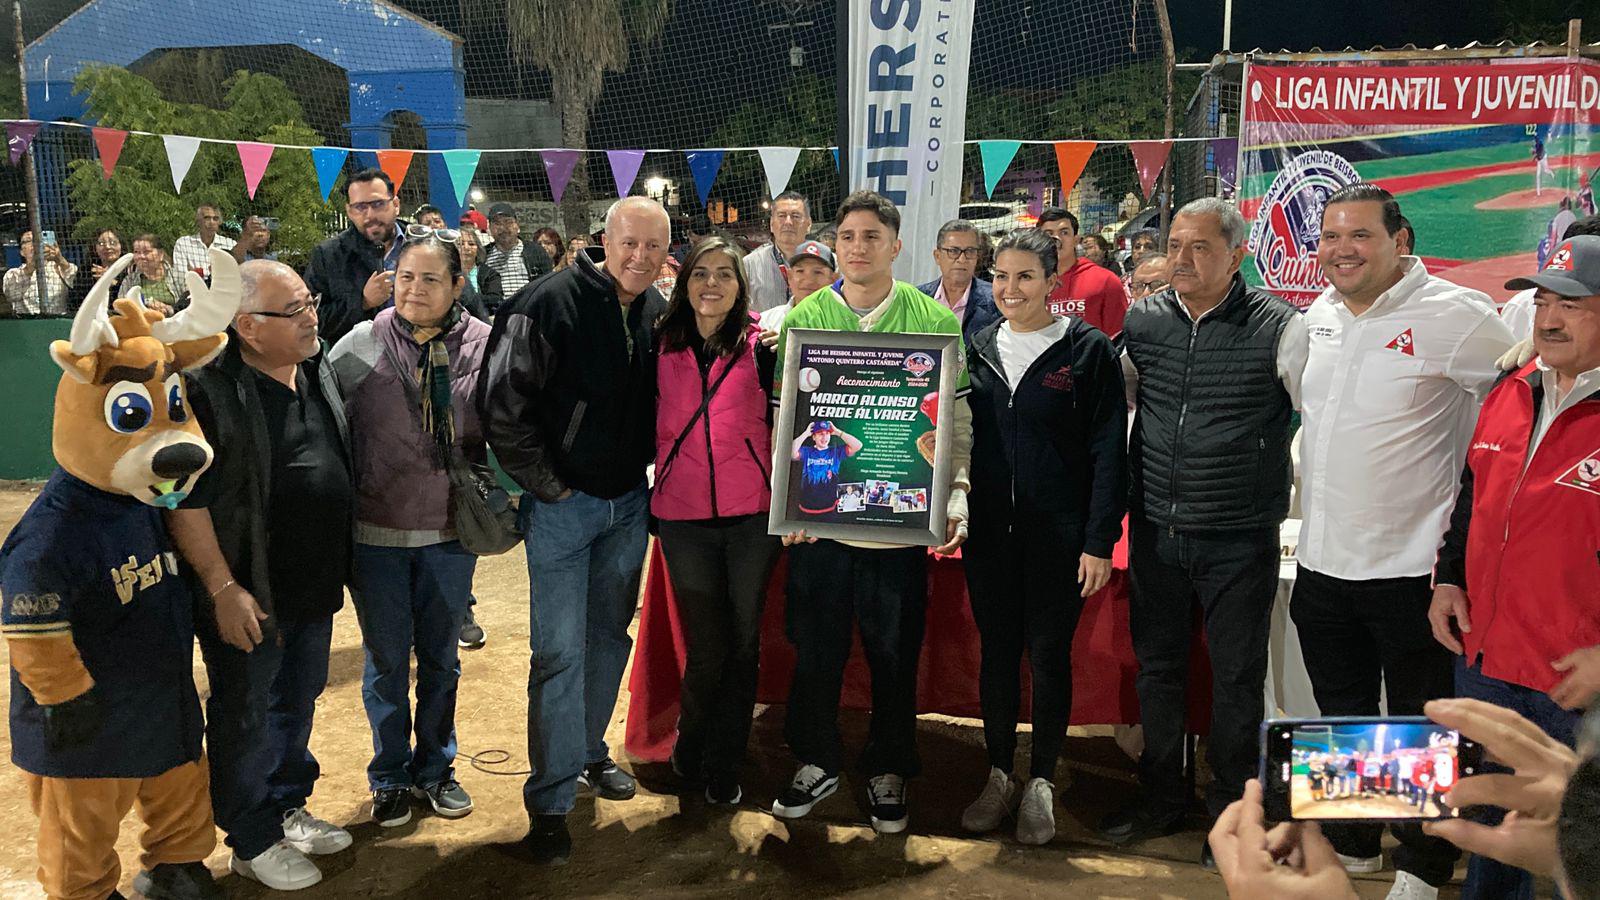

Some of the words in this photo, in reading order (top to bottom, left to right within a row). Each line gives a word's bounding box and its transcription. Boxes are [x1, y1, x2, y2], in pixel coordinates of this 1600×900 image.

[1275, 76, 1329, 110] LIGA
[1334, 76, 1447, 110] INFANTIL
[1453, 76, 1472, 110] Y
[1471, 74, 1577, 119] JUVENIL
[1580, 75, 1600, 110] D
[1249, 222, 1261, 250] LIGA
[1258, 170, 1288, 218] INFANTIL
[1323, 153, 1334, 166] DE
[1264, 237, 1330, 289] Quint
[835, 358, 865, 366] QUINTERO
[836, 375, 901, 388] Reconocimiento
[810, 392, 859, 406] MARCO
[860, 394, 918, 408] ALONSO
[809, 405, 854, 419] VERDE
[854, 406, 918, 422] ÁLVAREZ
